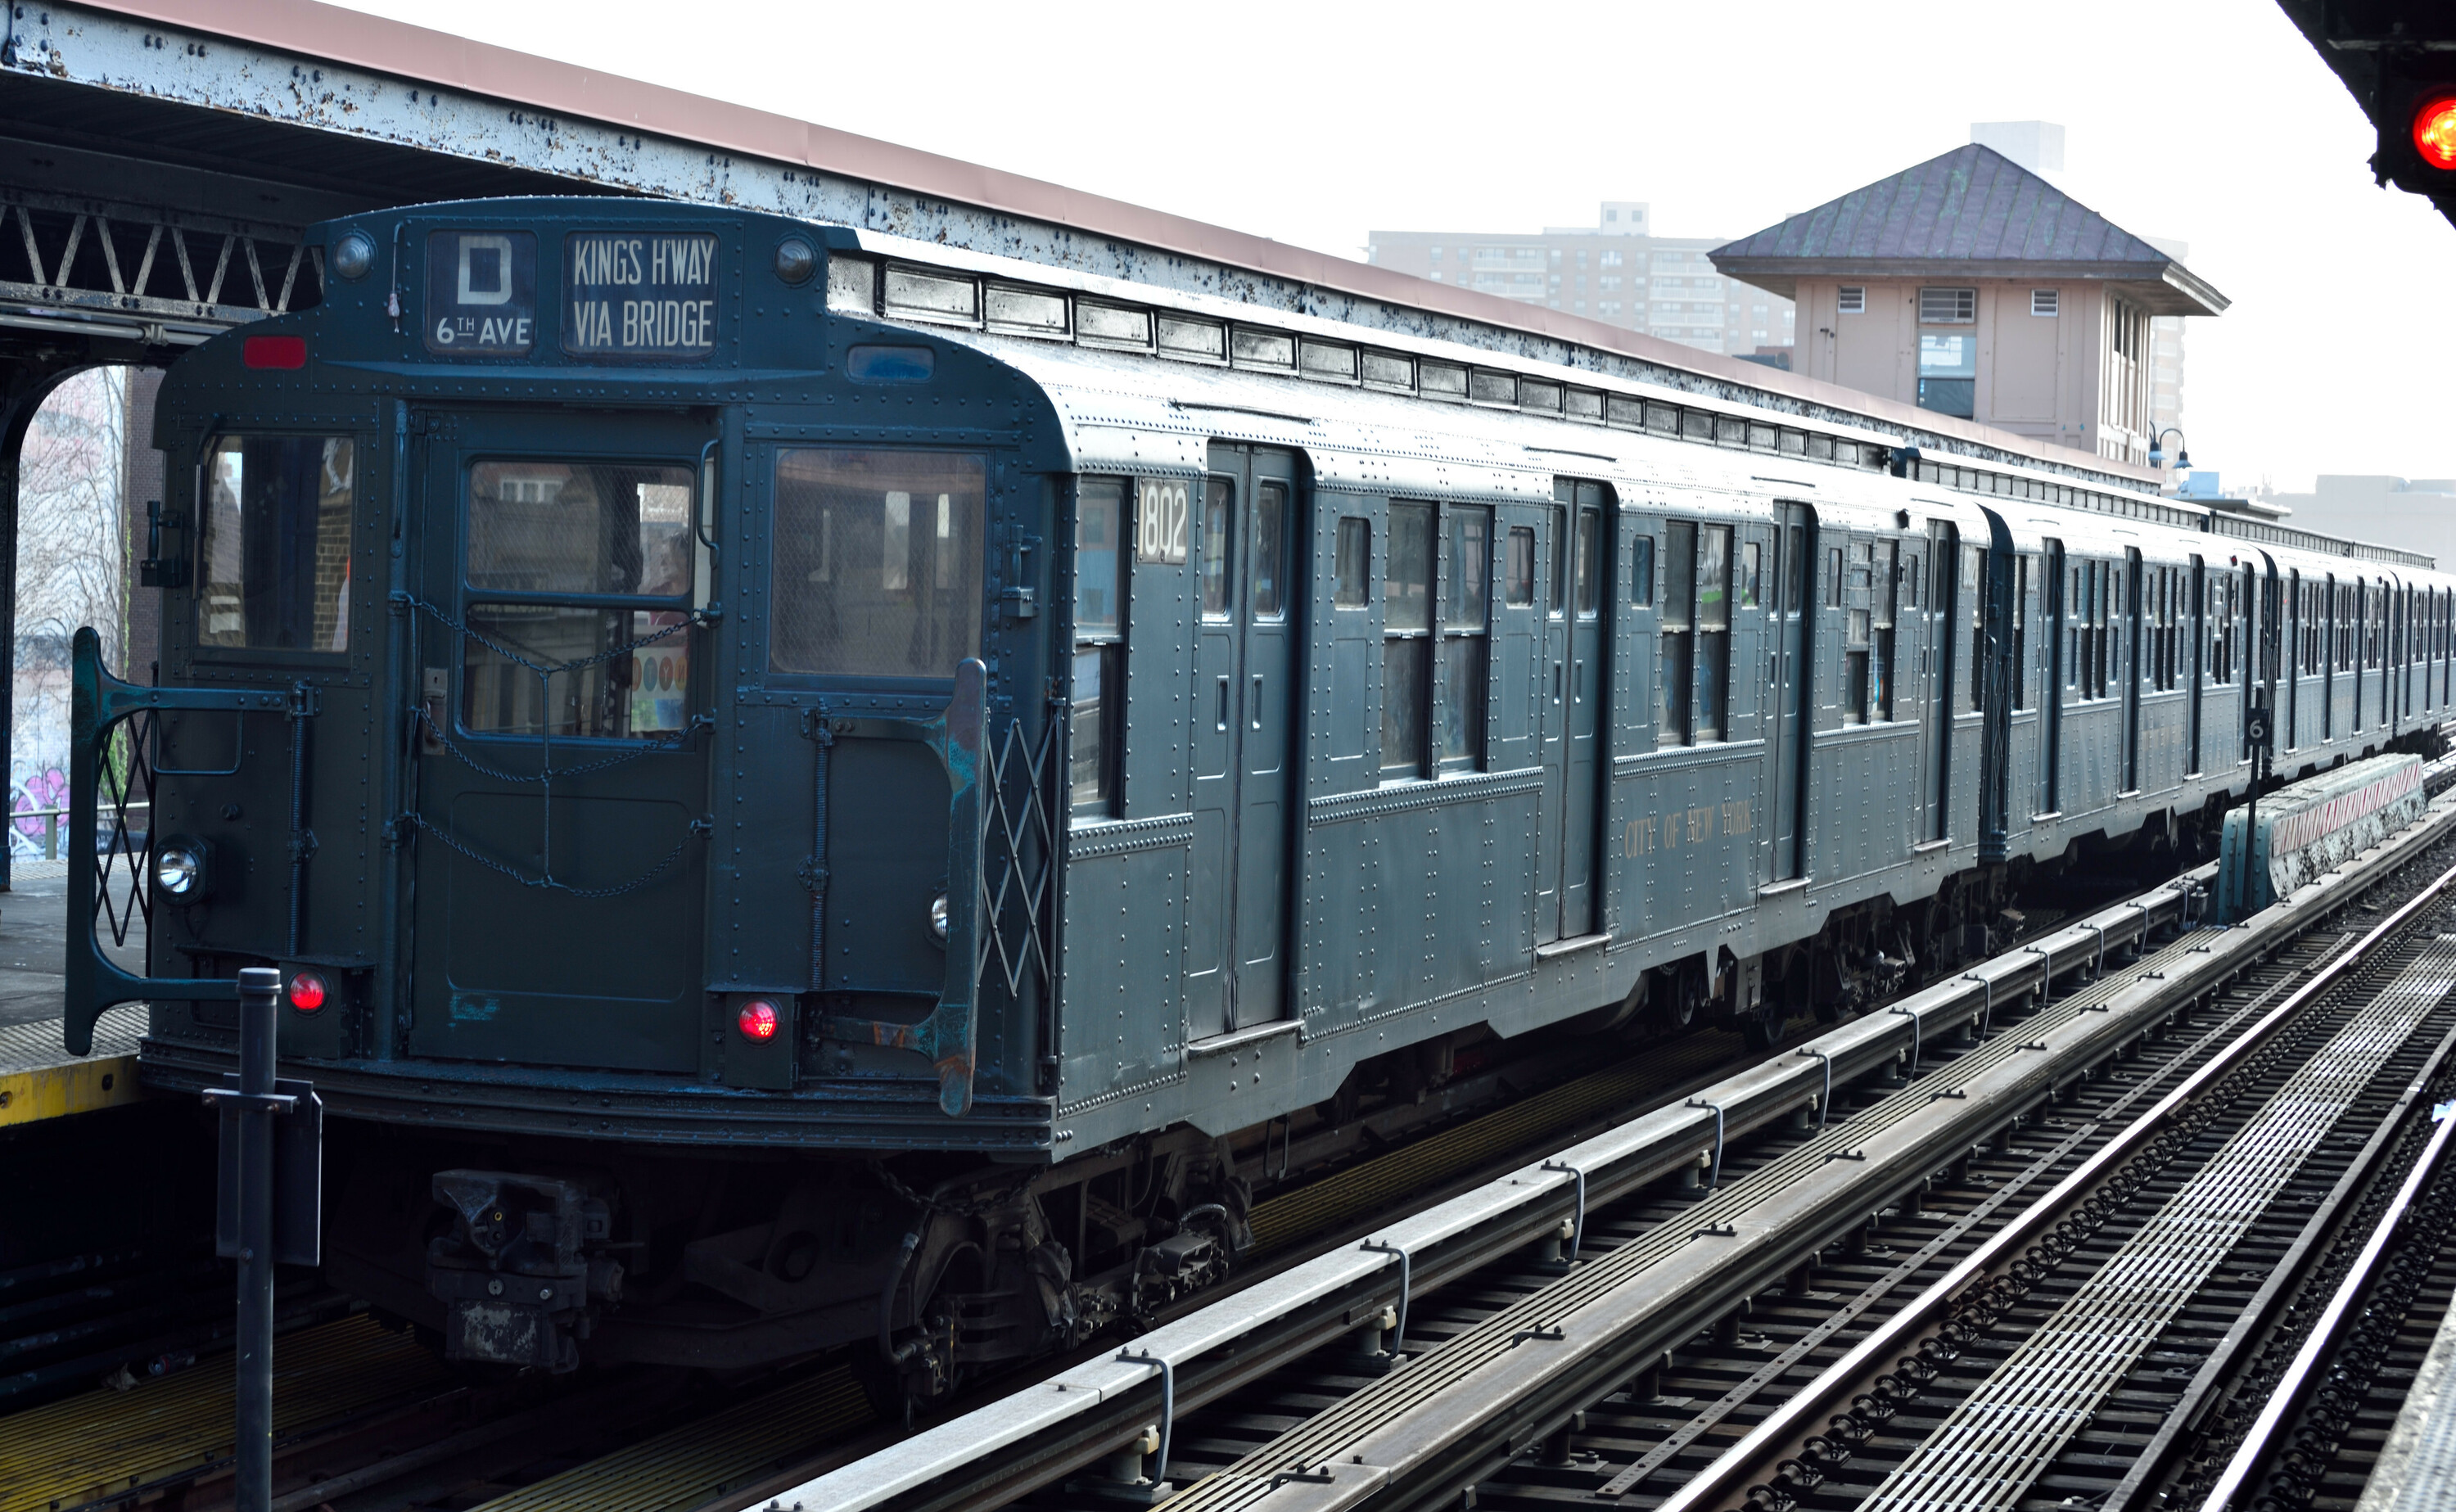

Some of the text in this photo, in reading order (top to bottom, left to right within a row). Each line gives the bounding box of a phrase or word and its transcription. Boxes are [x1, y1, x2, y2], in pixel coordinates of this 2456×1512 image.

[457, 235, 512, 305] D
[574, 239, 643, 286] KINGS
[479, 317, 532, 345] AVE
[573, 300, 714, 347] VIA BRIDGE
[1139, 485, 1187, 557] 1802
[2249, 719, 2264, 739] 6
[1624, 798, 1754, 860] CITY OF NEW YORK
